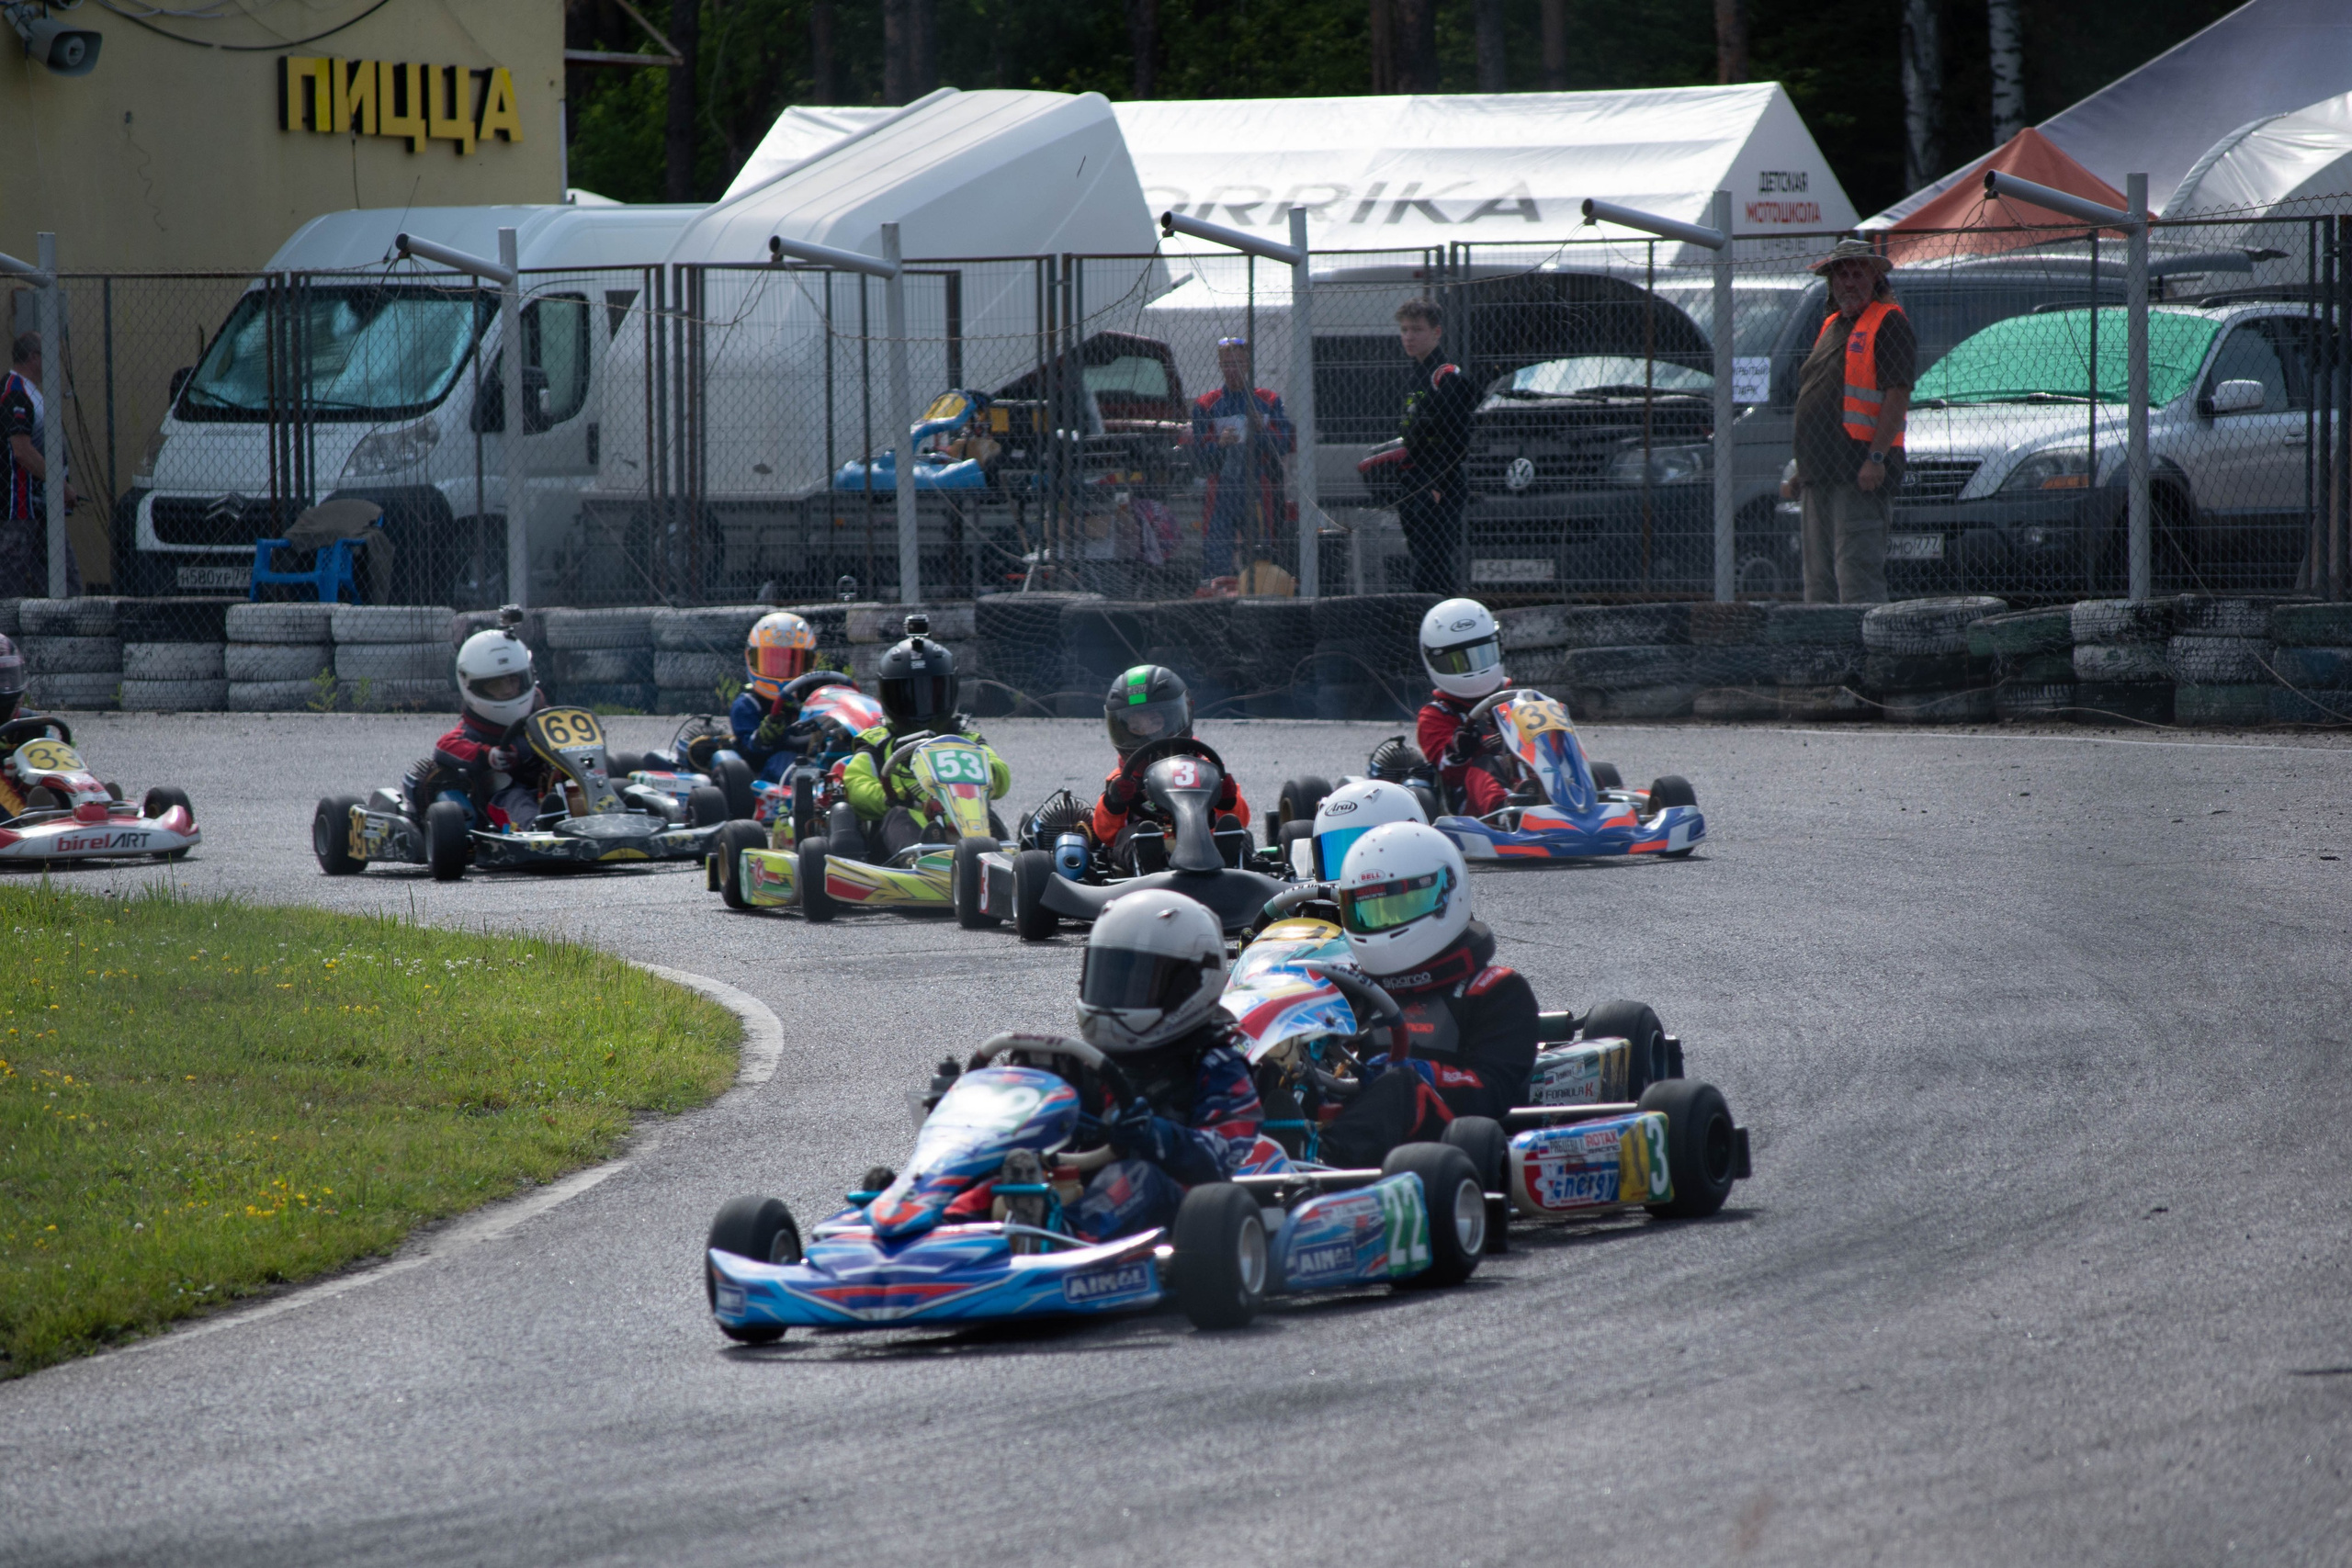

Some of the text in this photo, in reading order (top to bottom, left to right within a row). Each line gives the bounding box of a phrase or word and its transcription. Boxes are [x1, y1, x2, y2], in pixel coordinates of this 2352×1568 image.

[280, 56, 524, 154] ПИЦЦА
[1758, 171, 1808, 195] ДЕТСКАЯ
[1746, 201, 1822, 223] МОТОШКОЛА
[545, 714, 596, 744] 69
[1519, 704, 1572, 730] 39
[28, 747, 85, 771] 33
[935, 750, 984, 780] 53
[1174, 761, 1194, 785] 3
[1329, 802, 1354, 813] Arai
[1361, 873, 1381, 881] BELL
[1382, 972, 1432, 989] sparco
[1585, 1132, 1620, 1145] ROTAX
[1383, 1180, 1429, 1266] 22
